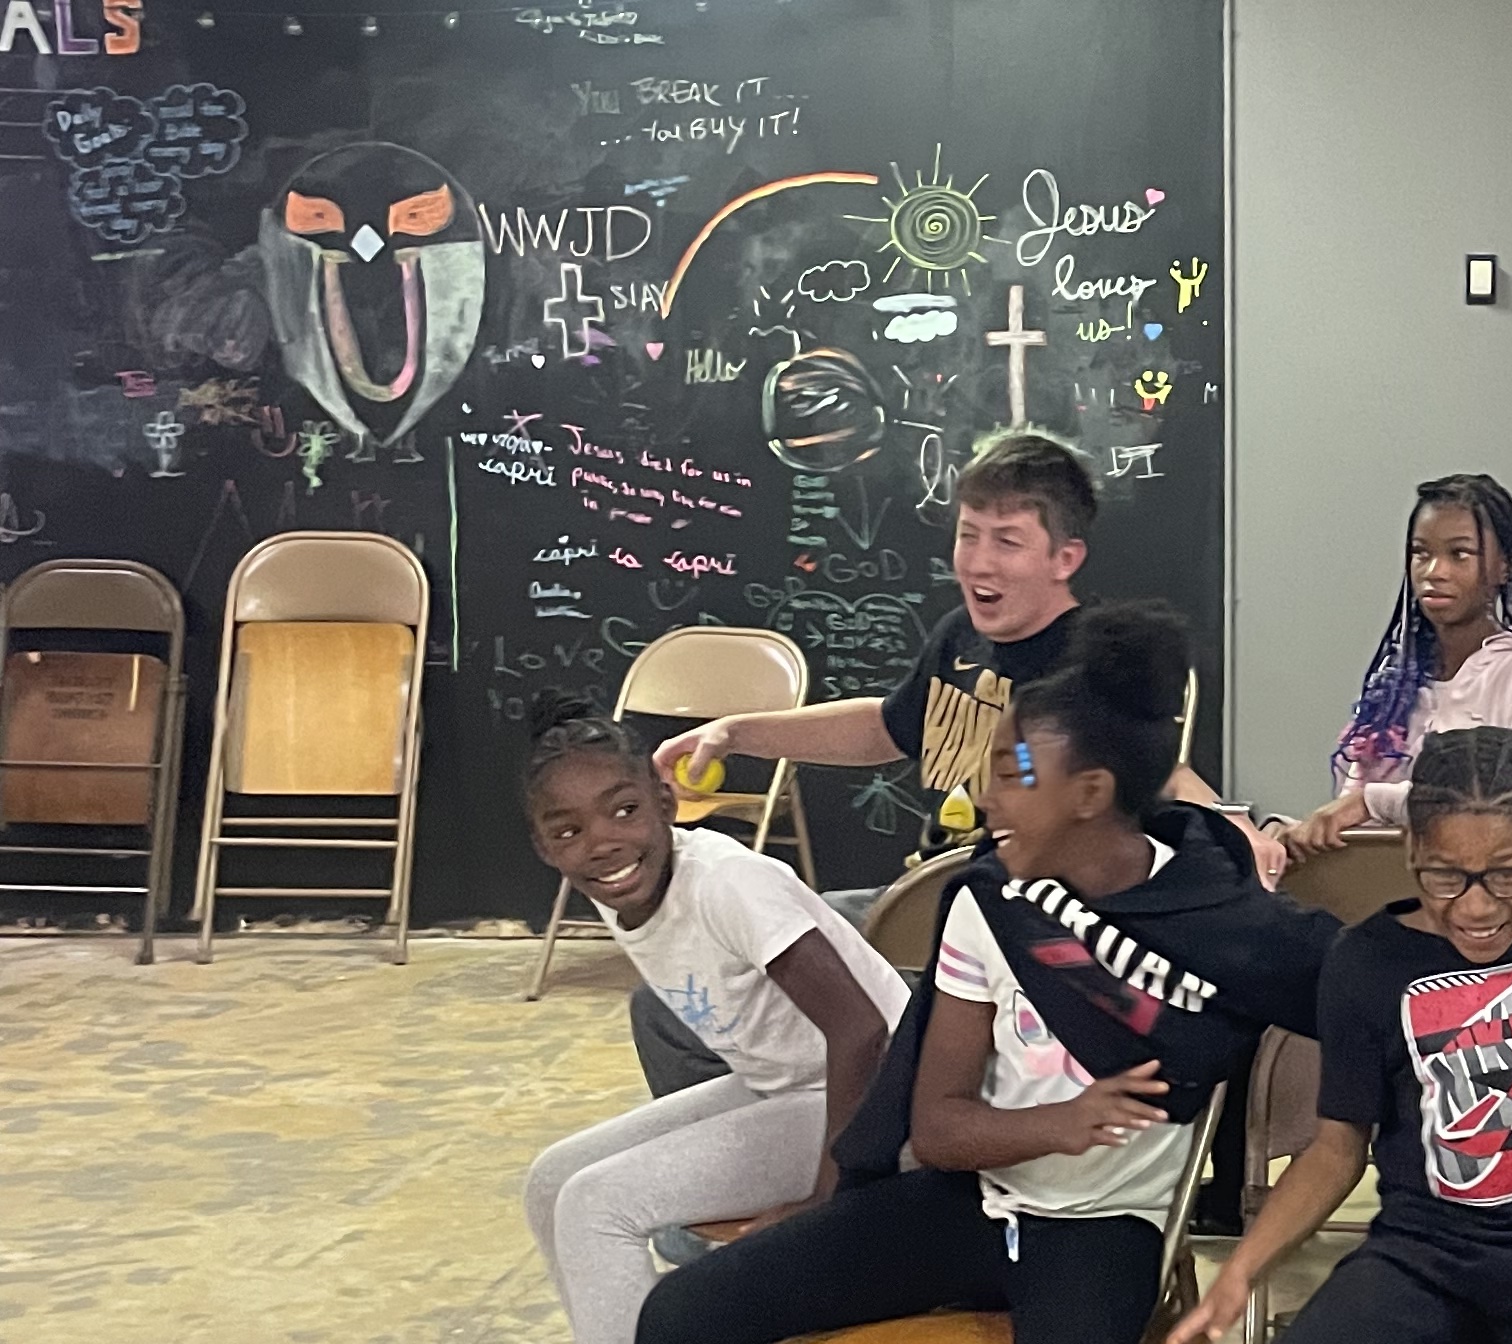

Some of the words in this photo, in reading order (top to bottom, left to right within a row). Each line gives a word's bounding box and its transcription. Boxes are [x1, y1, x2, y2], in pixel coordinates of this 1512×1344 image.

[630, 77, 723, 106] BREAK
[690, 118, 746, 154] BUY
[759, 107, 800, 137] IT!
[478, 203, 651, 261] WWJD
[1016, 168, 1156, 266] Jesus
